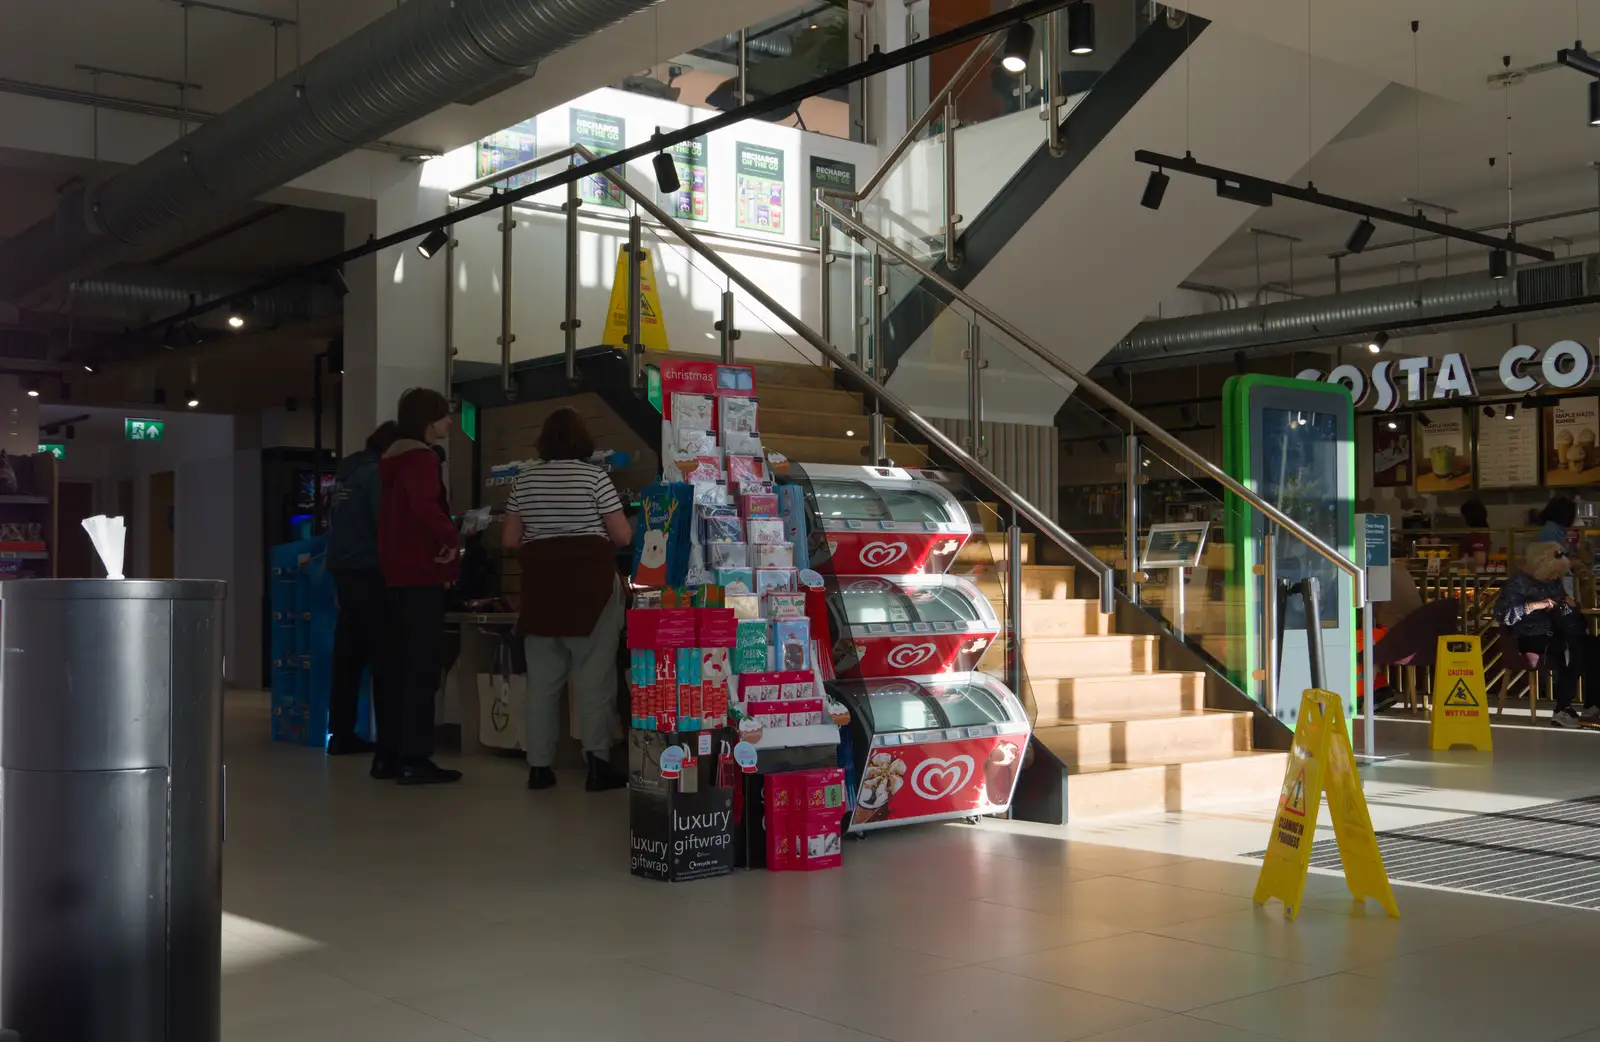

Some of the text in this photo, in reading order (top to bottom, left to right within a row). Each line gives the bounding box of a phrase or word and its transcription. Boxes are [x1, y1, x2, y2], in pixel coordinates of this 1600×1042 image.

[577, 119, 619, 132] RECHARGE
[590, 129, 605, 139] THE
[607, 132, 620, 141] GO
[691, 148, 702, 156] GO
[742, 151, 778, 165] RECHARGE
[769, 163, 778, 171] GO
[816, 166, 850, 179] RECHARGE
[666, 368, 713, 381] christmas
[1296, 353, 1478, 412] OSTA
[1445, 709, 1458, 717] WET
[673, 809, 731, 831] luxury
[1278, 816, 1298, 833] CLEANING
[631, 829, 668, 860] luxury
[674, 833, 731, 856] giftwrap
[1277, 831, 1300, 849] PROGRESS
[631, 854, 669, 876] giftwrap
